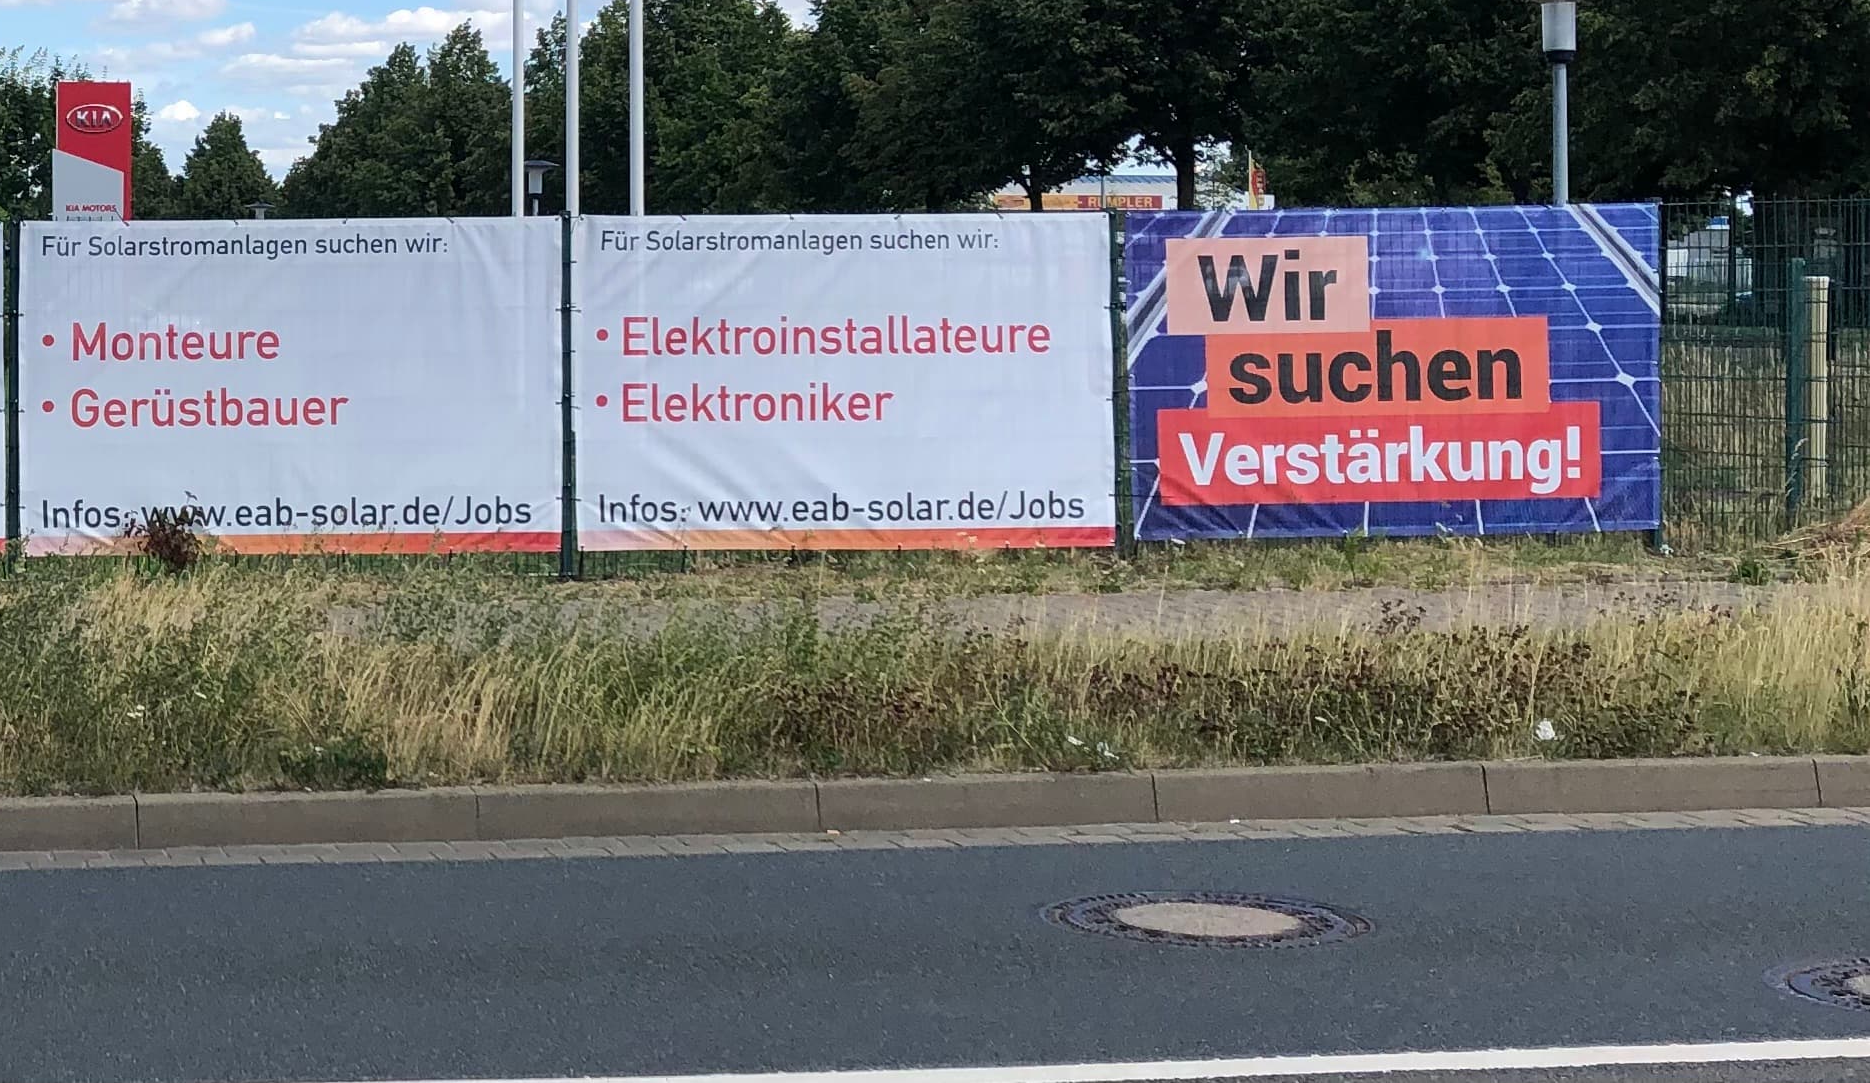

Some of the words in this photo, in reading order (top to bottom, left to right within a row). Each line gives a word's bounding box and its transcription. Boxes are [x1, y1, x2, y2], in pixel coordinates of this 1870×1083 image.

[76, 110, 112, 126] KIA
[65, 204, 80, 212] KIA
[81, 204, 116, 212] MOTORS
[41, 235, 81, 256] Für
[88, 234, 307, 261] Solarstromanlagen
[315, 232, 397, 254] suchen
[404, 232, 448, 253] wir:
[600, 229, 640, 251] Für
[646, 229, 863, 256] Solarstromanlagen
[869, 228, 950, 250] suchen
[956, 227, 999, 249] wir:
[1197, 249, 1338, 323] Wir
[72, 321, 280, 362] Monteure
[622, 314, 1051, 356] Elektroinstallateure
[1229, 329, 1523, 405] suchen
[71, 387, 350, 429] Gerüstbauer
[622, 382, 894, 423] Elektroniker
[1178, 425, 1581, 495] Verstärkung!
[42, 499, 129, 528] Infos:
[599, 493, 687, 523] Infos:
[697, 490, 1085, 523] www.eab-solar.de/Jobs
